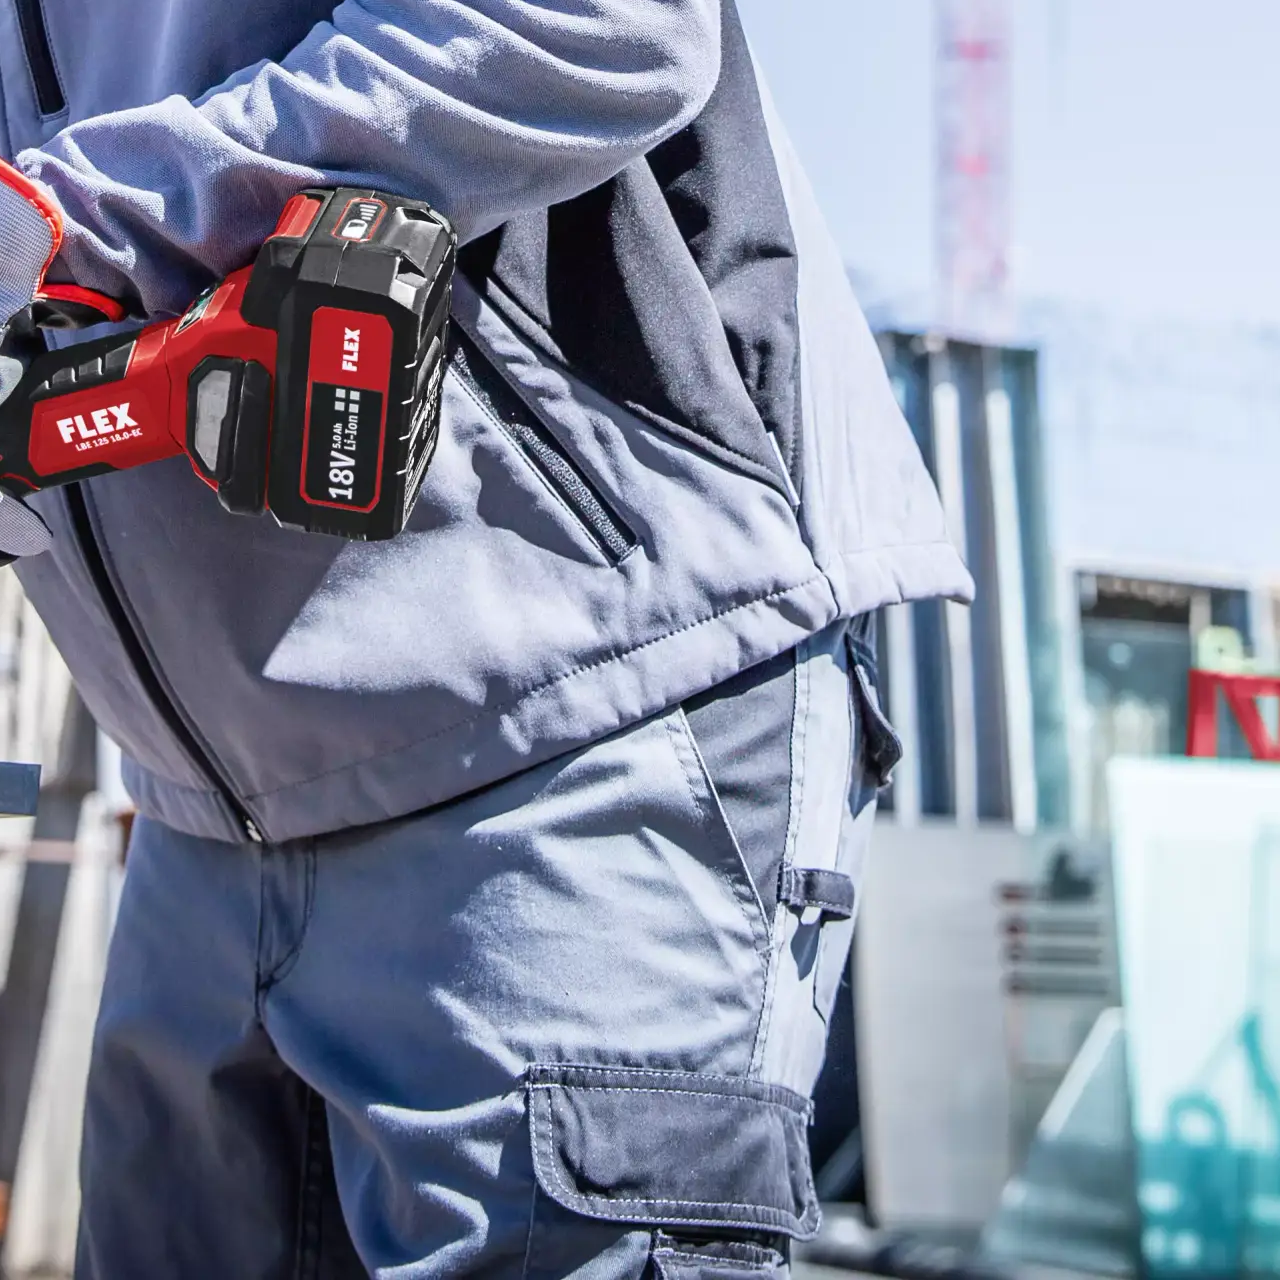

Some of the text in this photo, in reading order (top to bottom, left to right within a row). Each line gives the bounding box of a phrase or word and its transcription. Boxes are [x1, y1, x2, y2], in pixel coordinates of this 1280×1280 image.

[342, 326, 360, 372] FLEX
[56, 402, 138, 444] FLEX
[75, 428, 143, 452] LBE 125 18.0-EC
[332, 422, 343, 449] 5.0 Ah
[344, 415, 358, 451] Li-Ion
[328, 450, 356, 500] 18V
